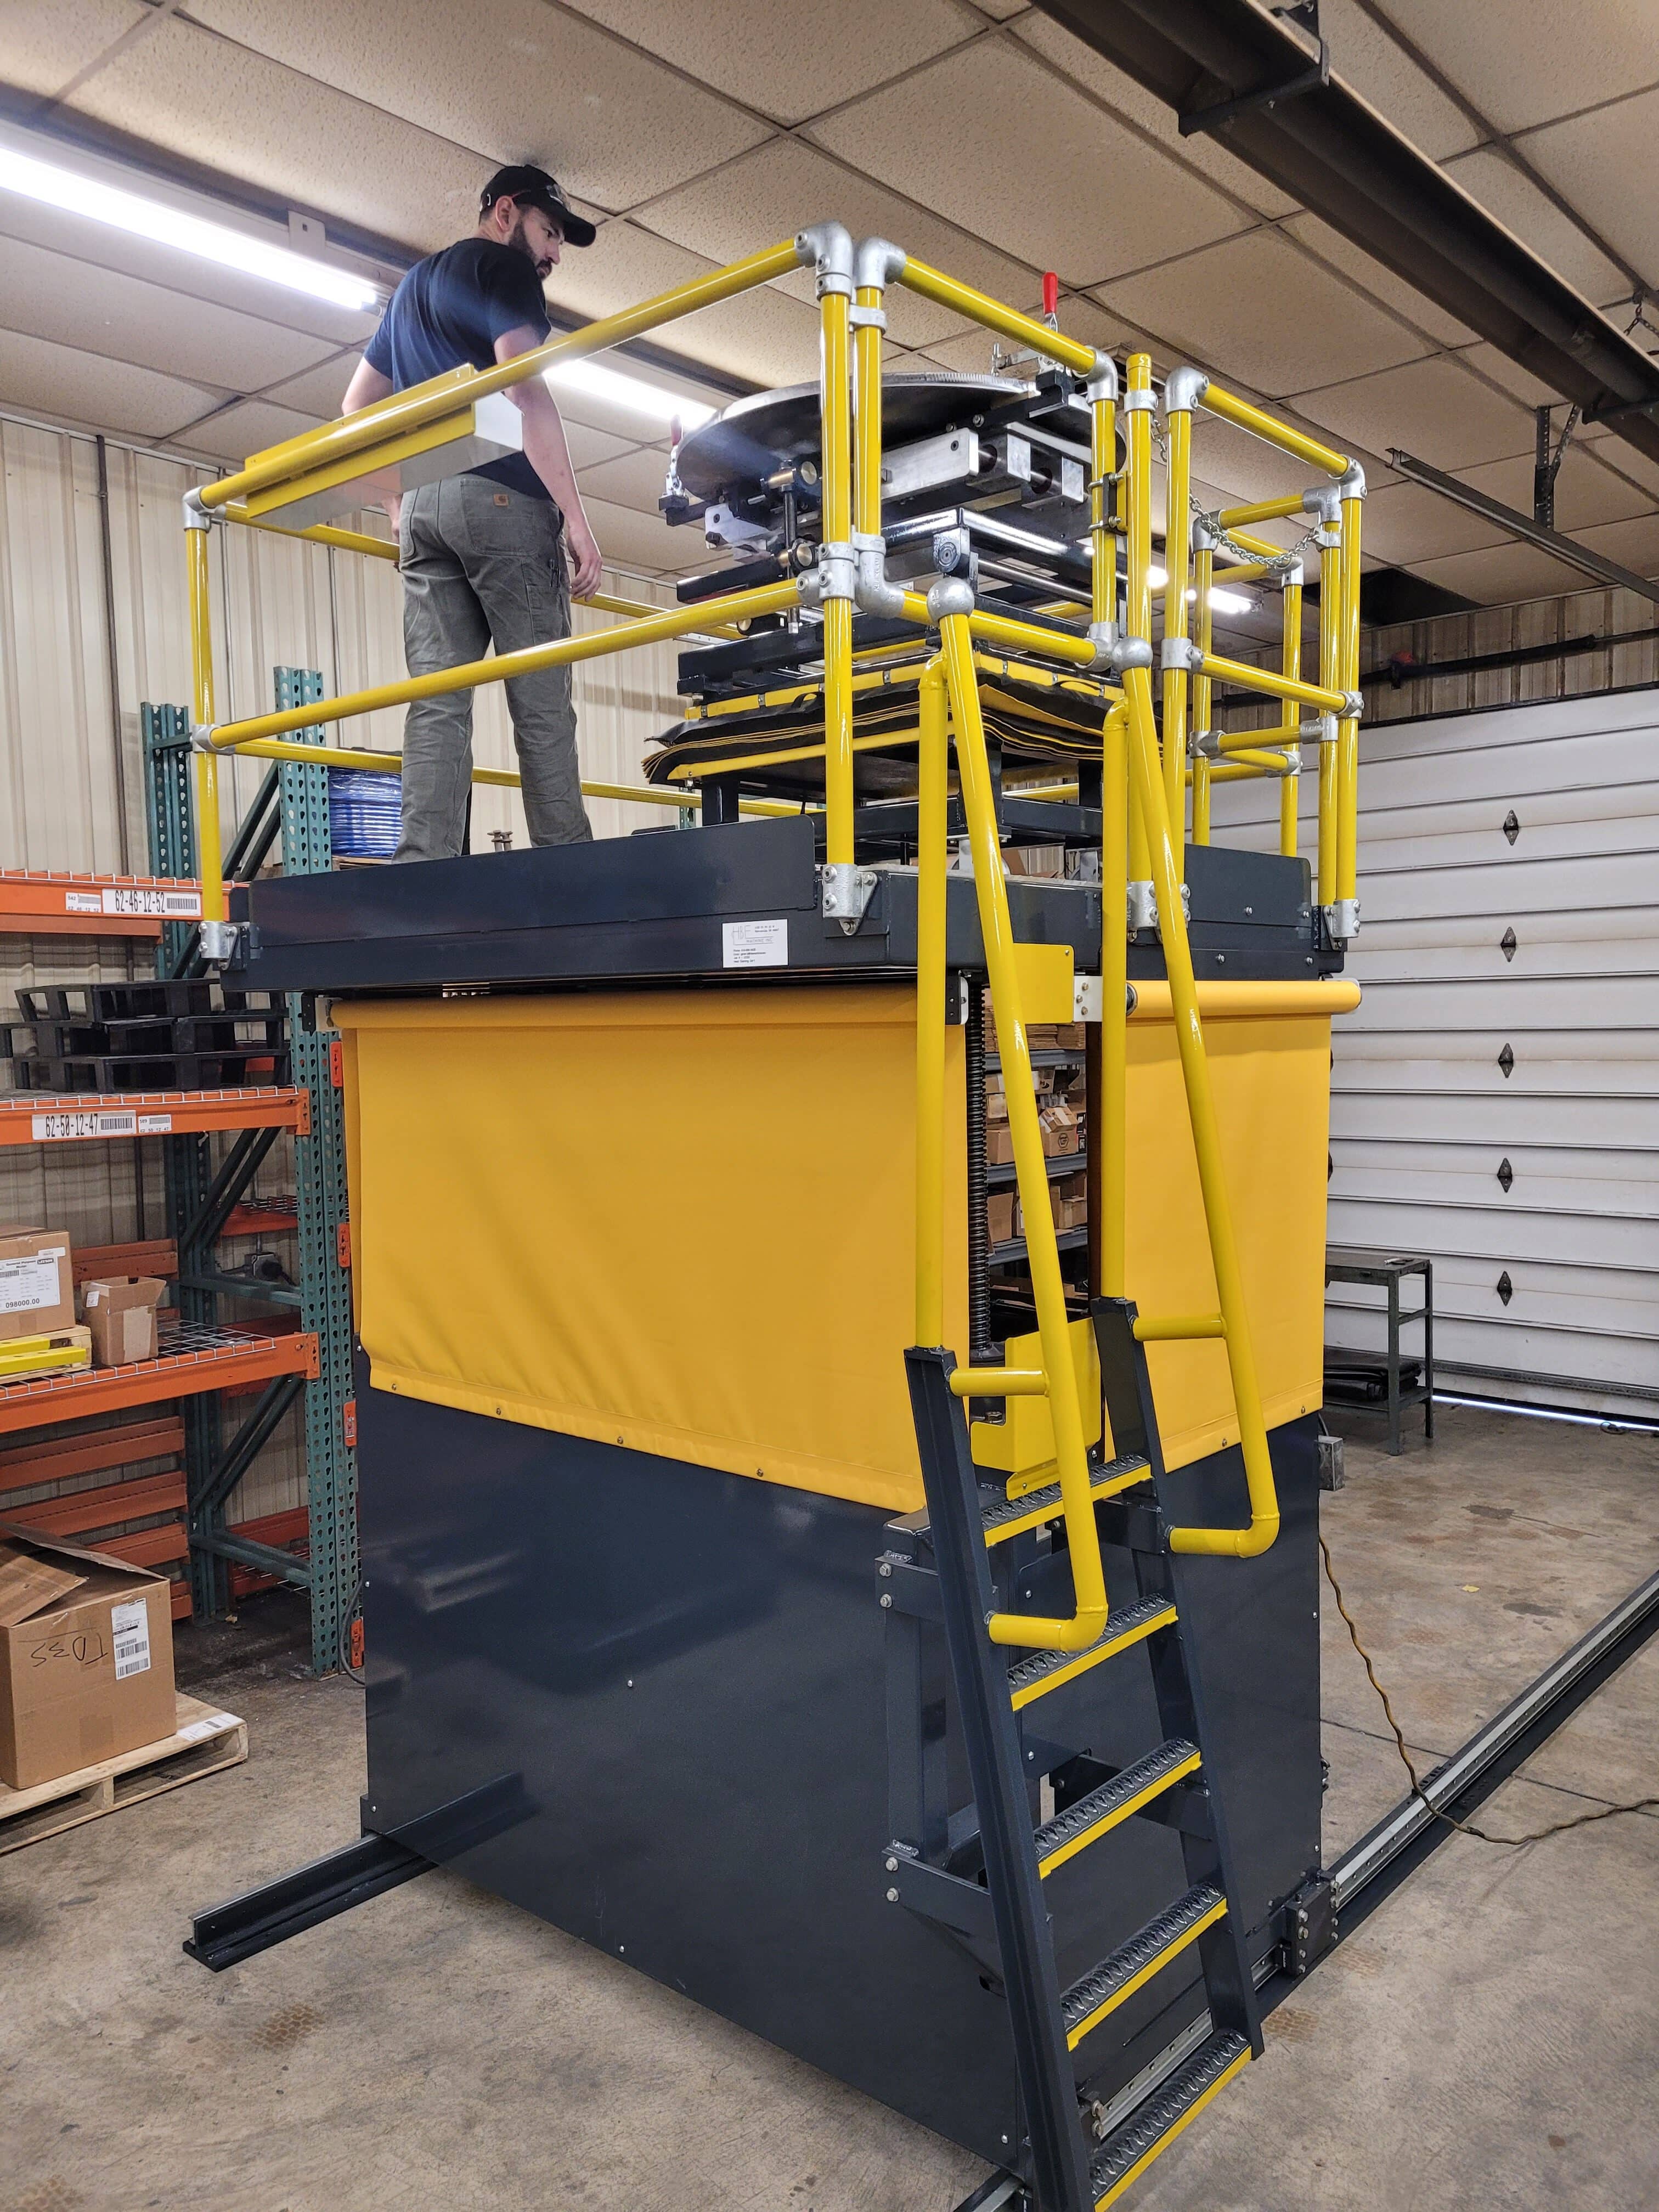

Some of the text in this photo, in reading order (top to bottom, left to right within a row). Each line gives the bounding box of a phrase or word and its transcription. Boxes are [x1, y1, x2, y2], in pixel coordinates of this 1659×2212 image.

[115, 890, 165, 913] 62-46-12-52
[46, 1113, 98, 1138] 62-50-12-47
[5, 1298, 40, 1308] 098000.00
